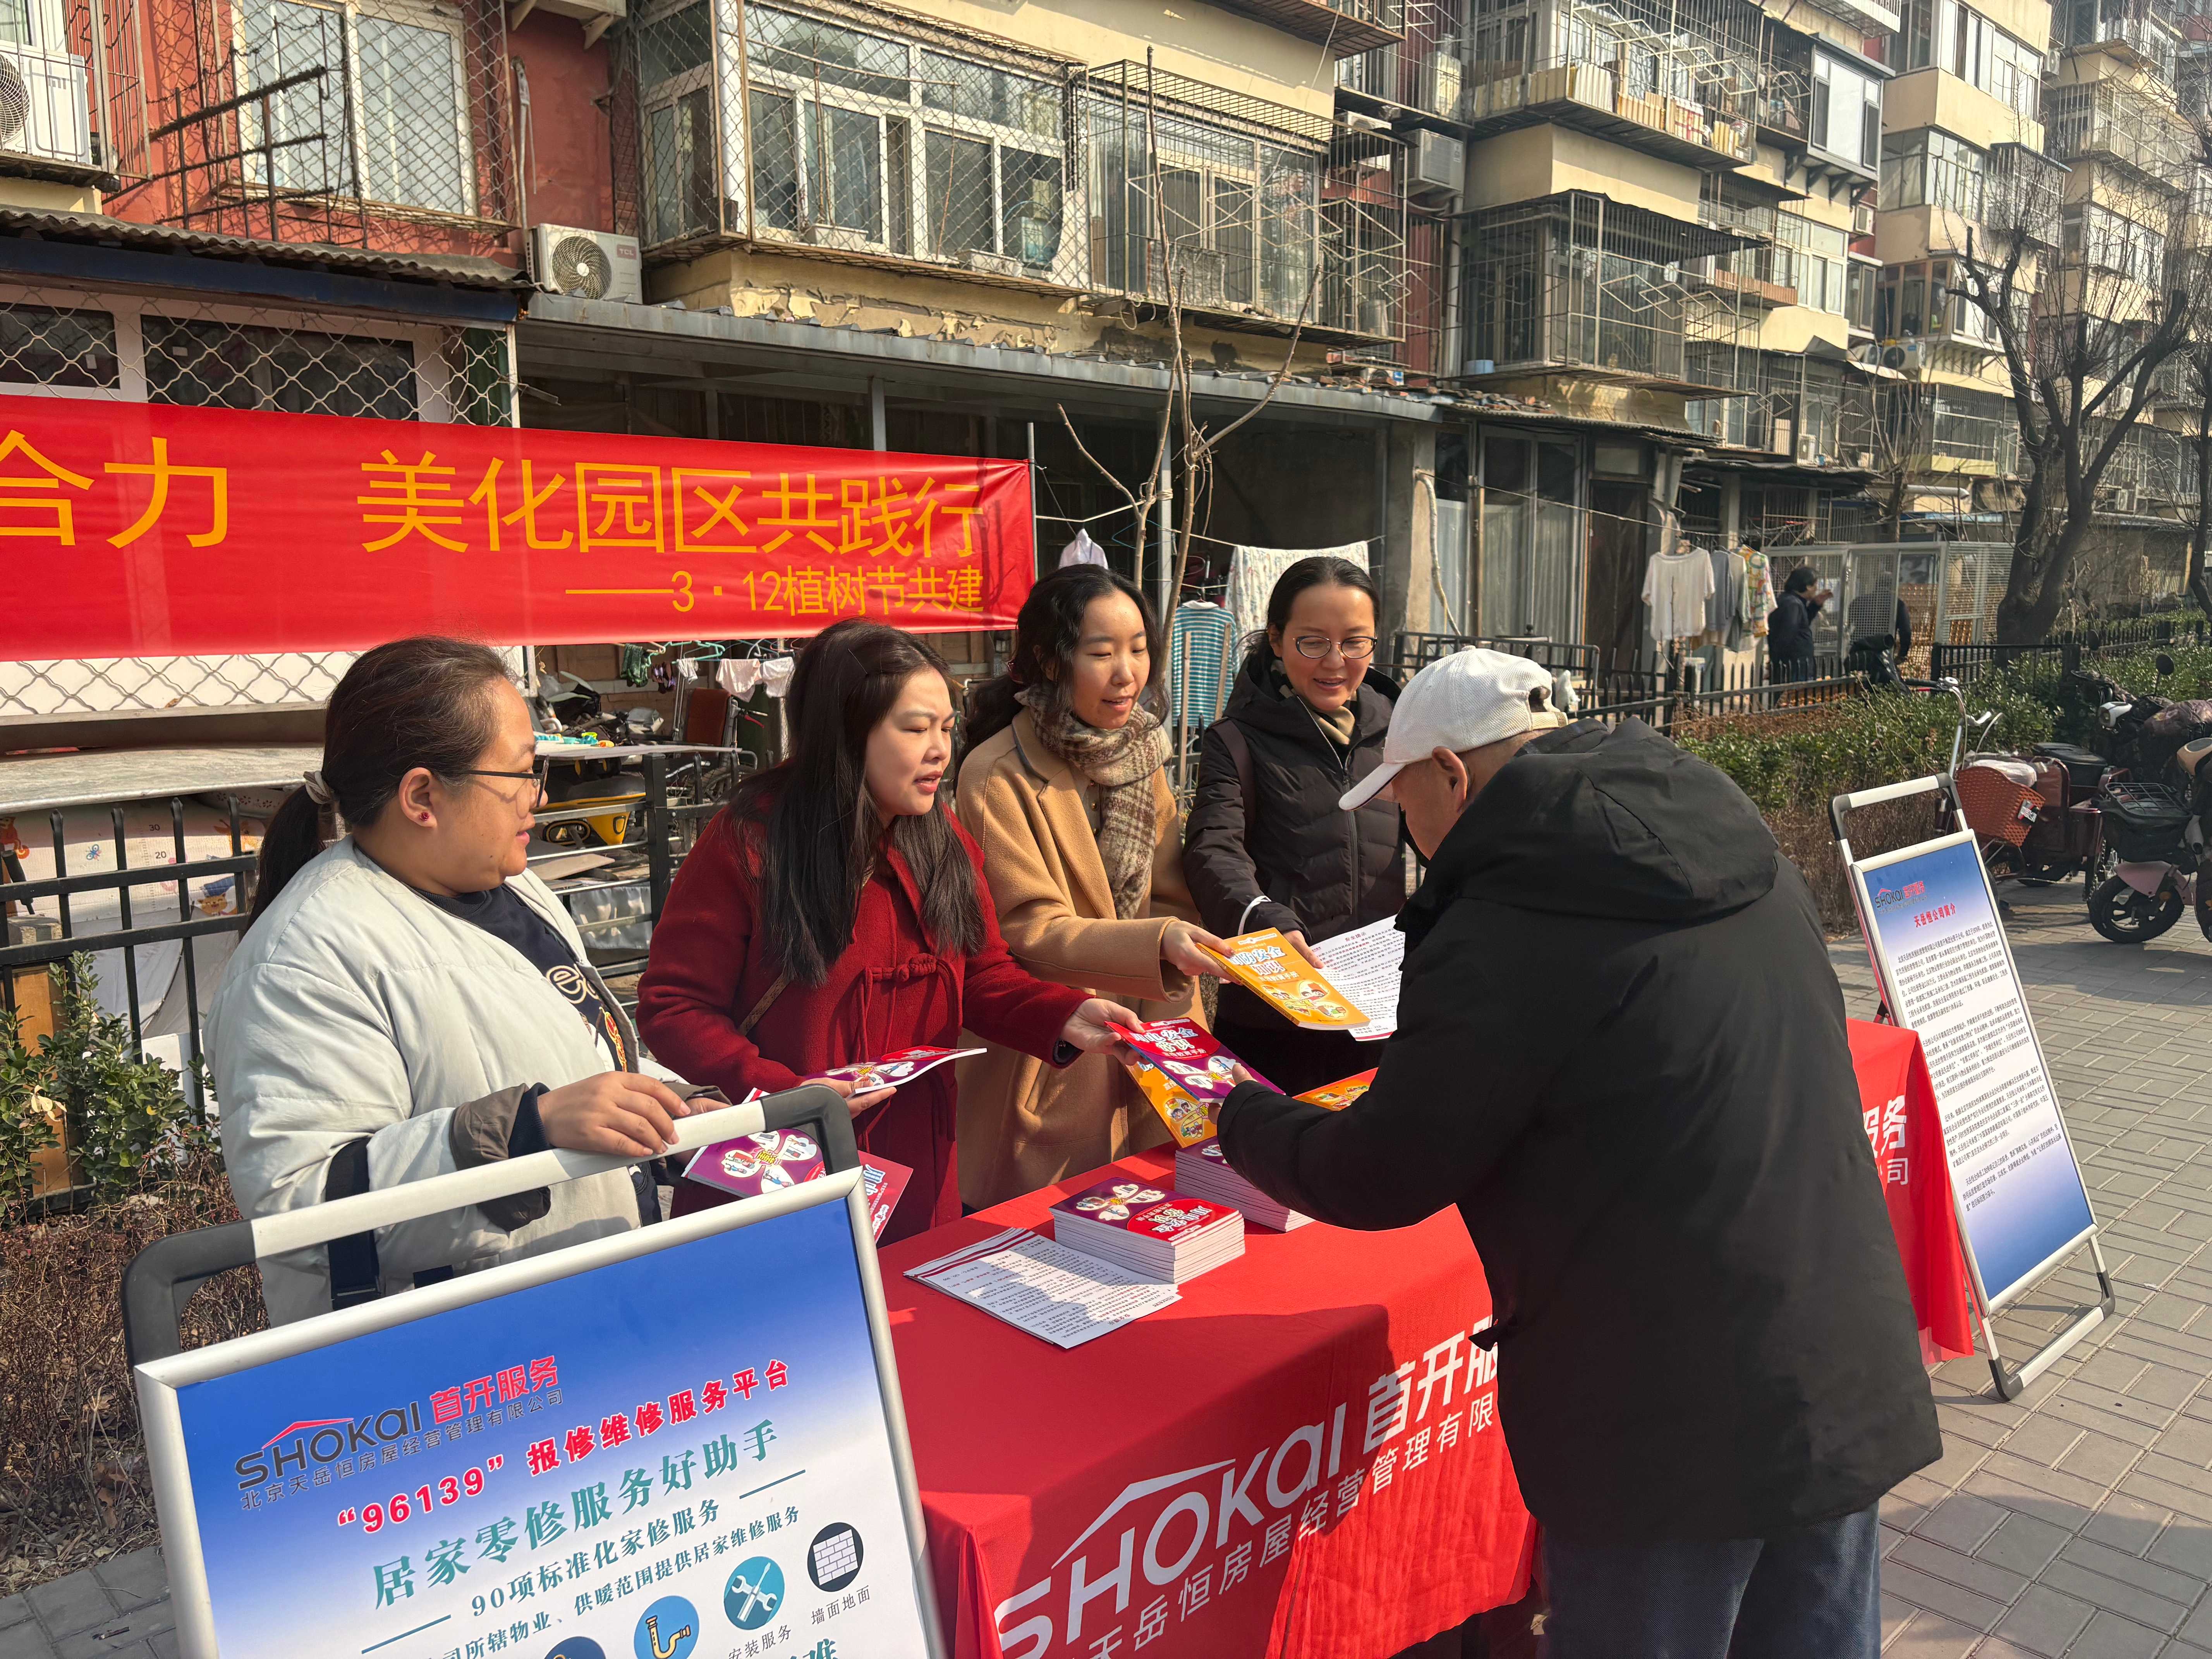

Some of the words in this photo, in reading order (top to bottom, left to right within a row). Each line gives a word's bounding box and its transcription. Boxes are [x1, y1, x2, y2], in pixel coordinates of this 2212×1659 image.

[356, 449, 984, 558] 美化园区共践行
[155, 851, 167, 859] 20
[1879, 1158, 1908, 1185] 司
[430, 1355, 558, 1424] 首开服务
[526, 1359, 789, 1477] 报修维修服务平台
[240, 1388, 563, 1511] 北京天岳恒房屋经营管理有限公司
[373, 1419, 778, 1610] 居家零修服务好助手
[471, 1499, 720, 1617] 90项标准化家修服务
[1072, 1391, 1493, 1659] 天岳恒房屋经营管理有限
[428, 1506, 800, 1659] 司所辖物业、供暖范围提供居家维修服务
[811, 1584, 871, 1626] 墙面地面
[728, 1624, 792, 1659] 安装服务
